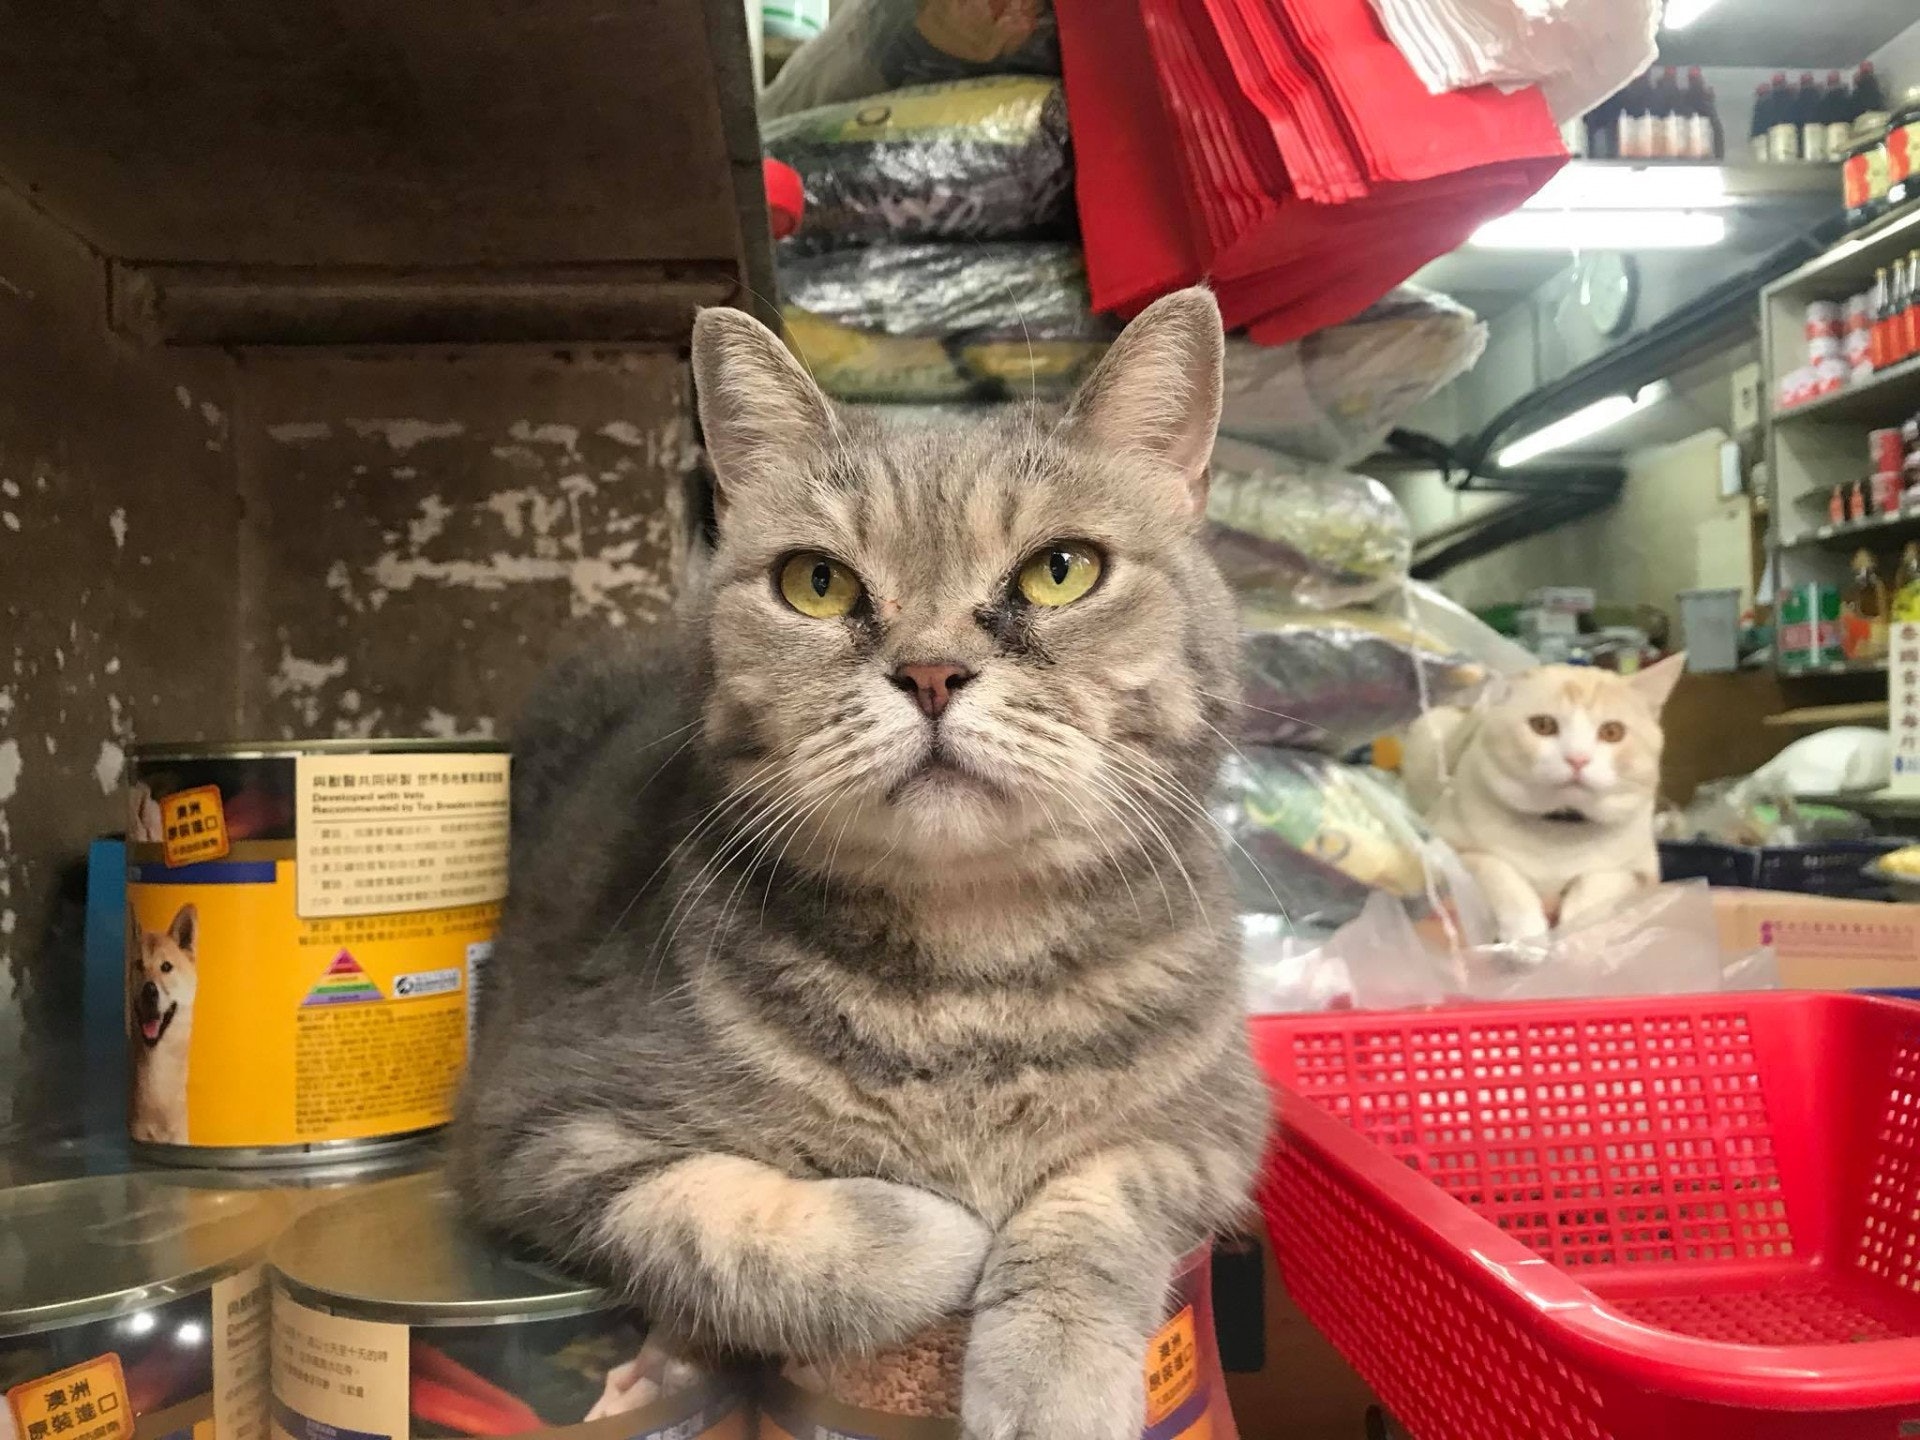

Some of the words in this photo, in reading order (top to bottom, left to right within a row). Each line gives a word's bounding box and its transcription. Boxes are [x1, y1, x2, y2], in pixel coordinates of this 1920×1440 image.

[312, 792, 374, 802] Developed
[377, 791, 400, 801] with
[312, 803, 399, 814] Recommended
[402, 803, 414, 813] by
[45, 1377, 92, 1412] 澳洲
[26, 1392, 120, 1440] 原裝進口
